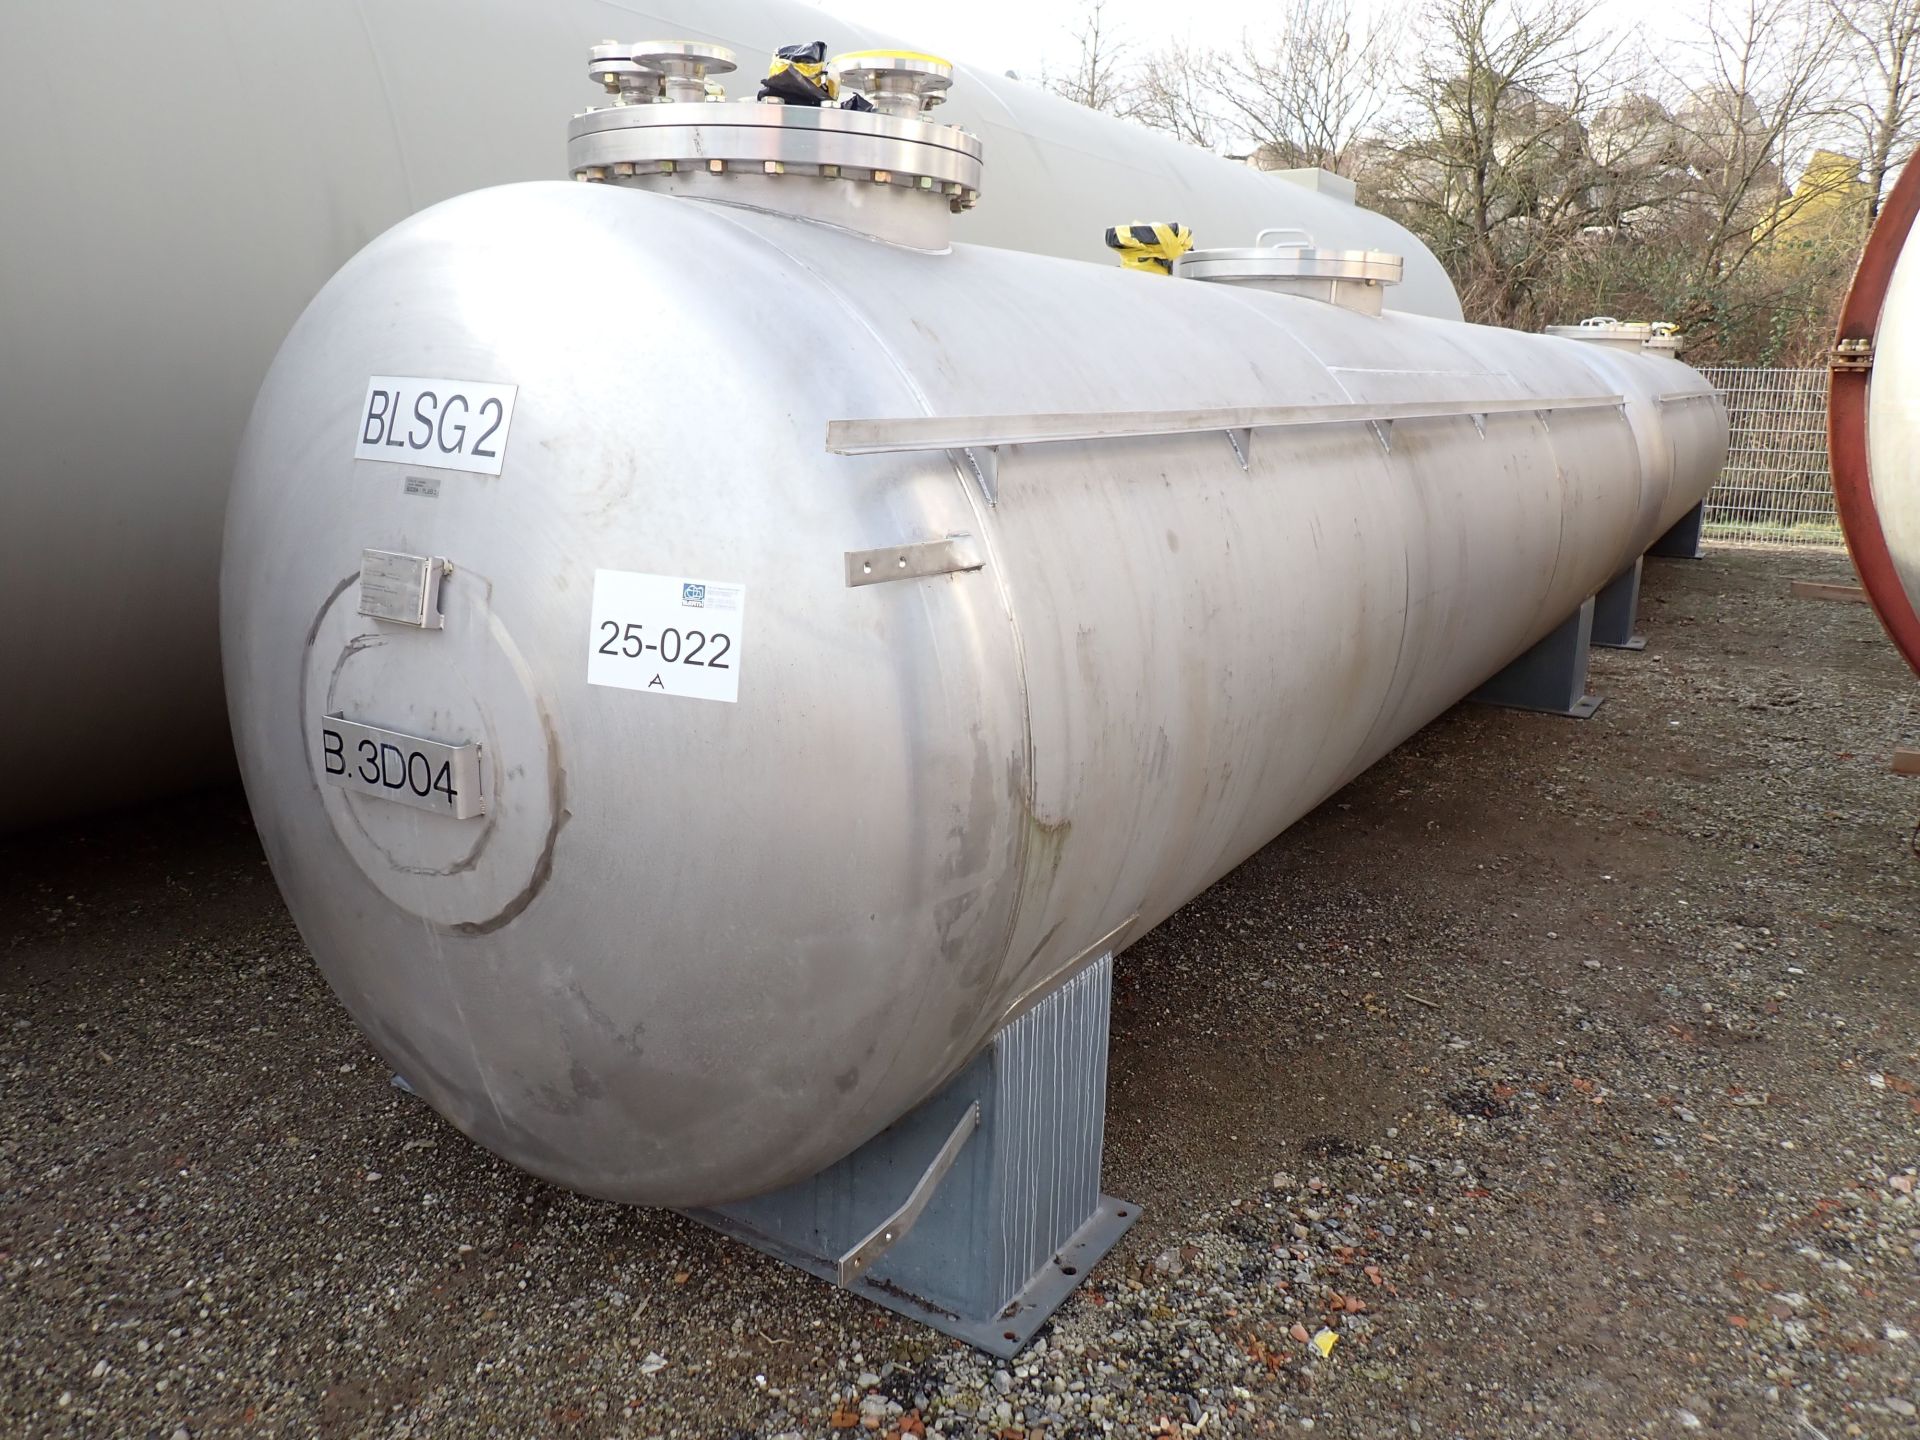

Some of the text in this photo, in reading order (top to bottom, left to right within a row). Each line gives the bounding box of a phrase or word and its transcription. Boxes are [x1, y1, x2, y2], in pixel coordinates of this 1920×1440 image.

[362, 390, 503, 458] BLSG2
[598, 620, 731, 669] 25-022
[648, 673, 665, 689] A
